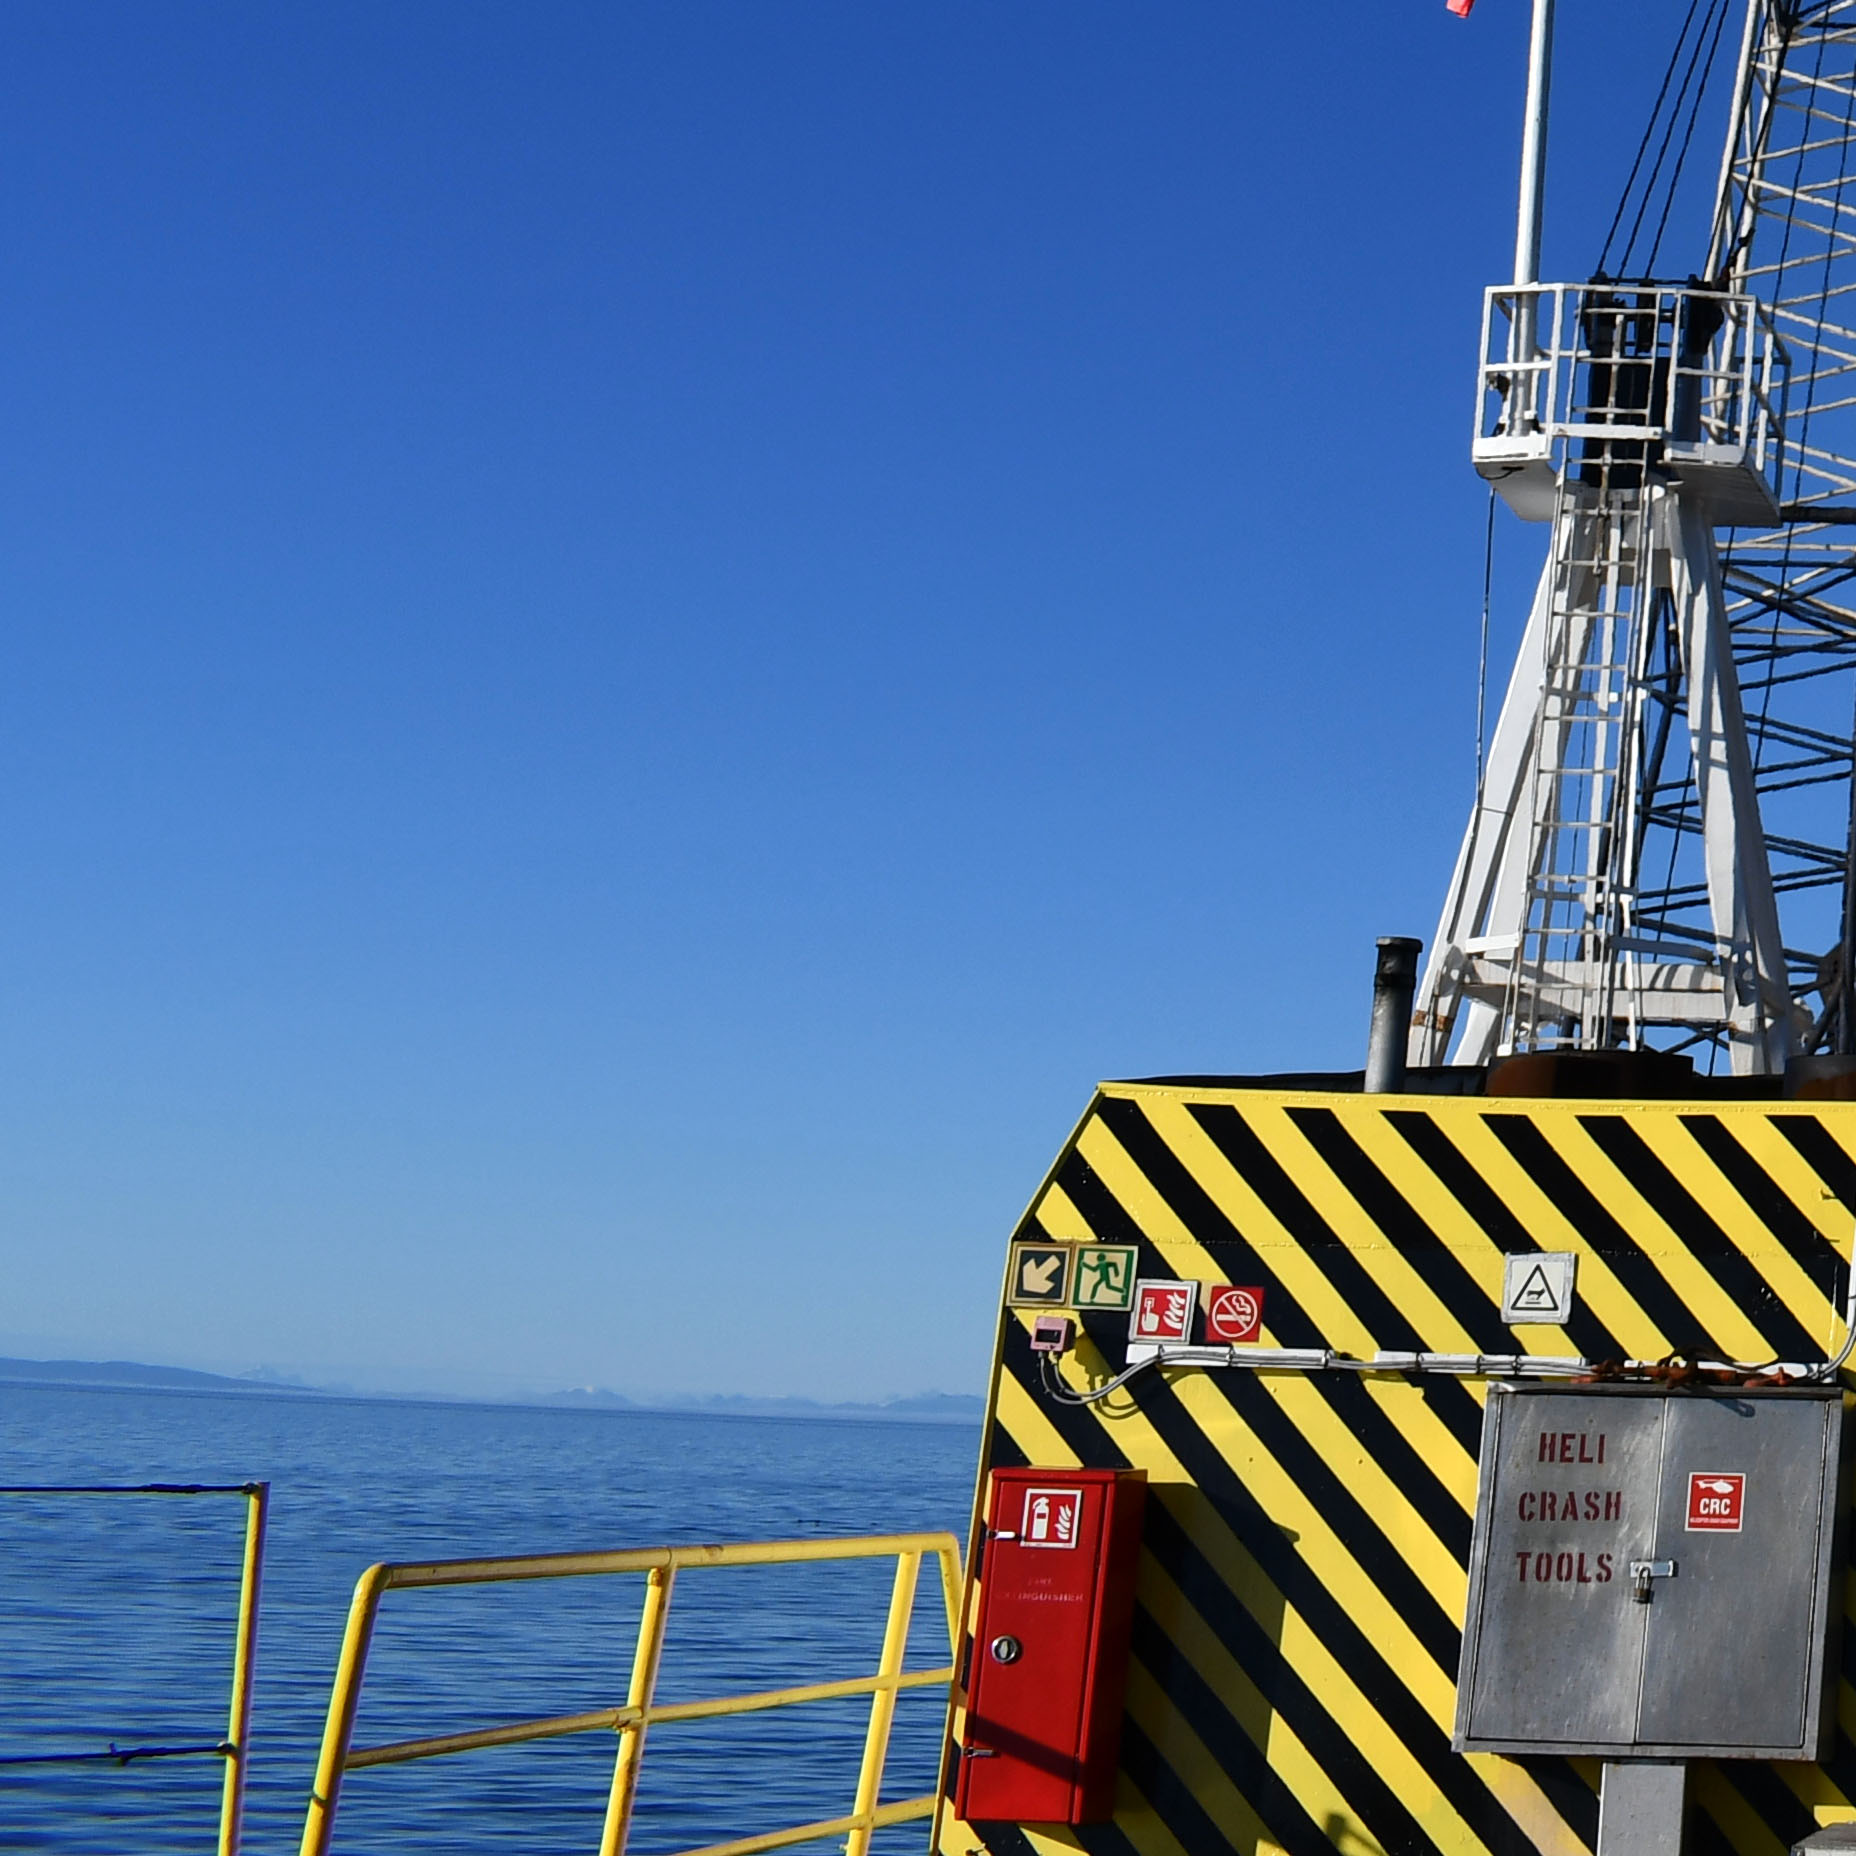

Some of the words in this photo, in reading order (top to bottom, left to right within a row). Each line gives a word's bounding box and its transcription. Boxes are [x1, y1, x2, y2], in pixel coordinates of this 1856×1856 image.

[1538, 1432, 1606, 1464] HELI
[1518, 1491, 1622, 1523] CRASH
[1699, 1497, 1731, 1516] CRC
[1516, 1551, 1613, 1584] TOOLS
